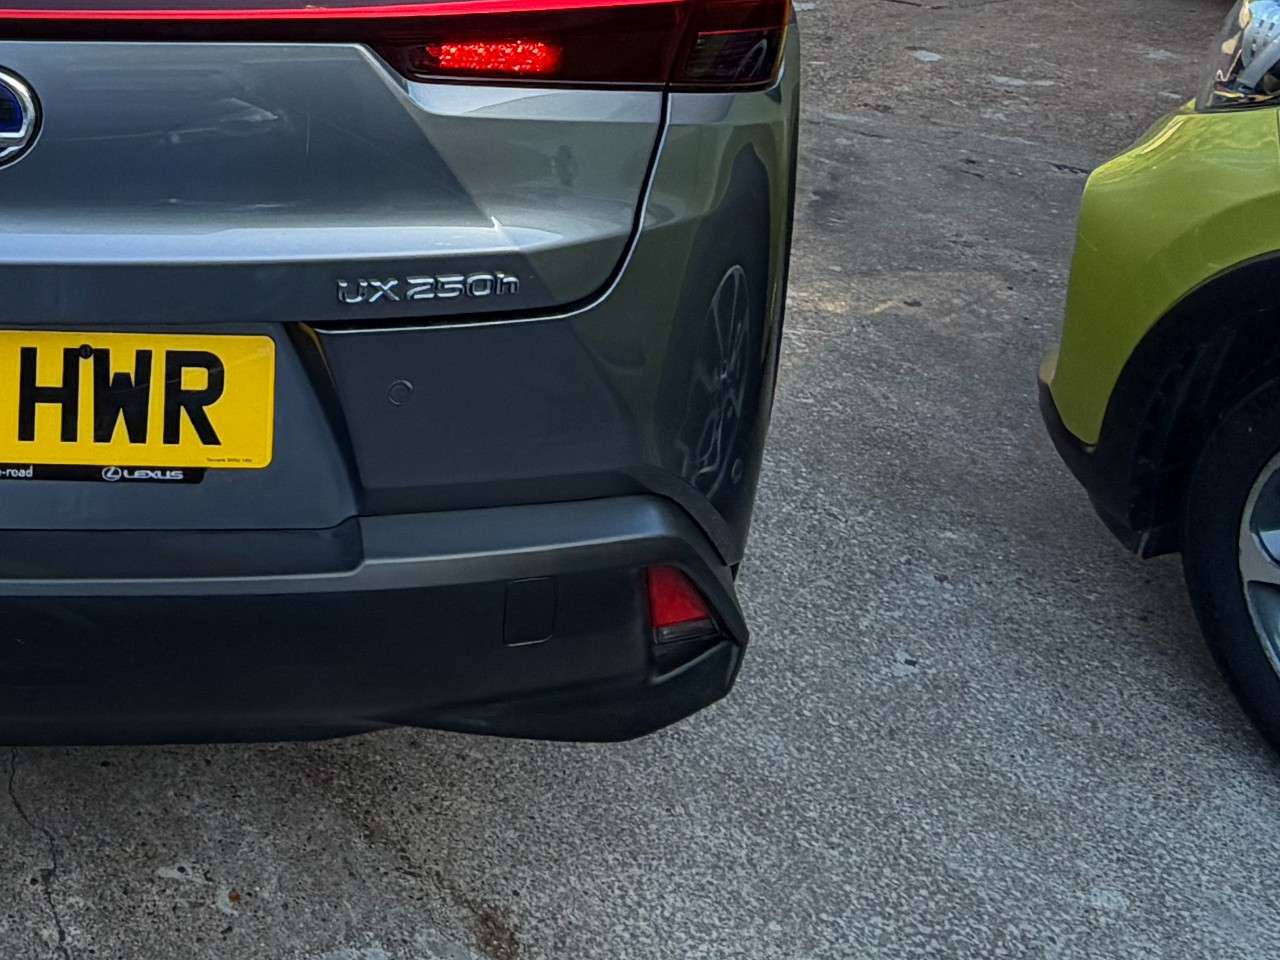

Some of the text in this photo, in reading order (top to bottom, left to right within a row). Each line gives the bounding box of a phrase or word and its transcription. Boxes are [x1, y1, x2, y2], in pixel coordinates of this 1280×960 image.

[338, 271, 519, 303] UX 250h
[18, 346, 225, 446] HWR
[123, 469, 184, 480] LEXUS
